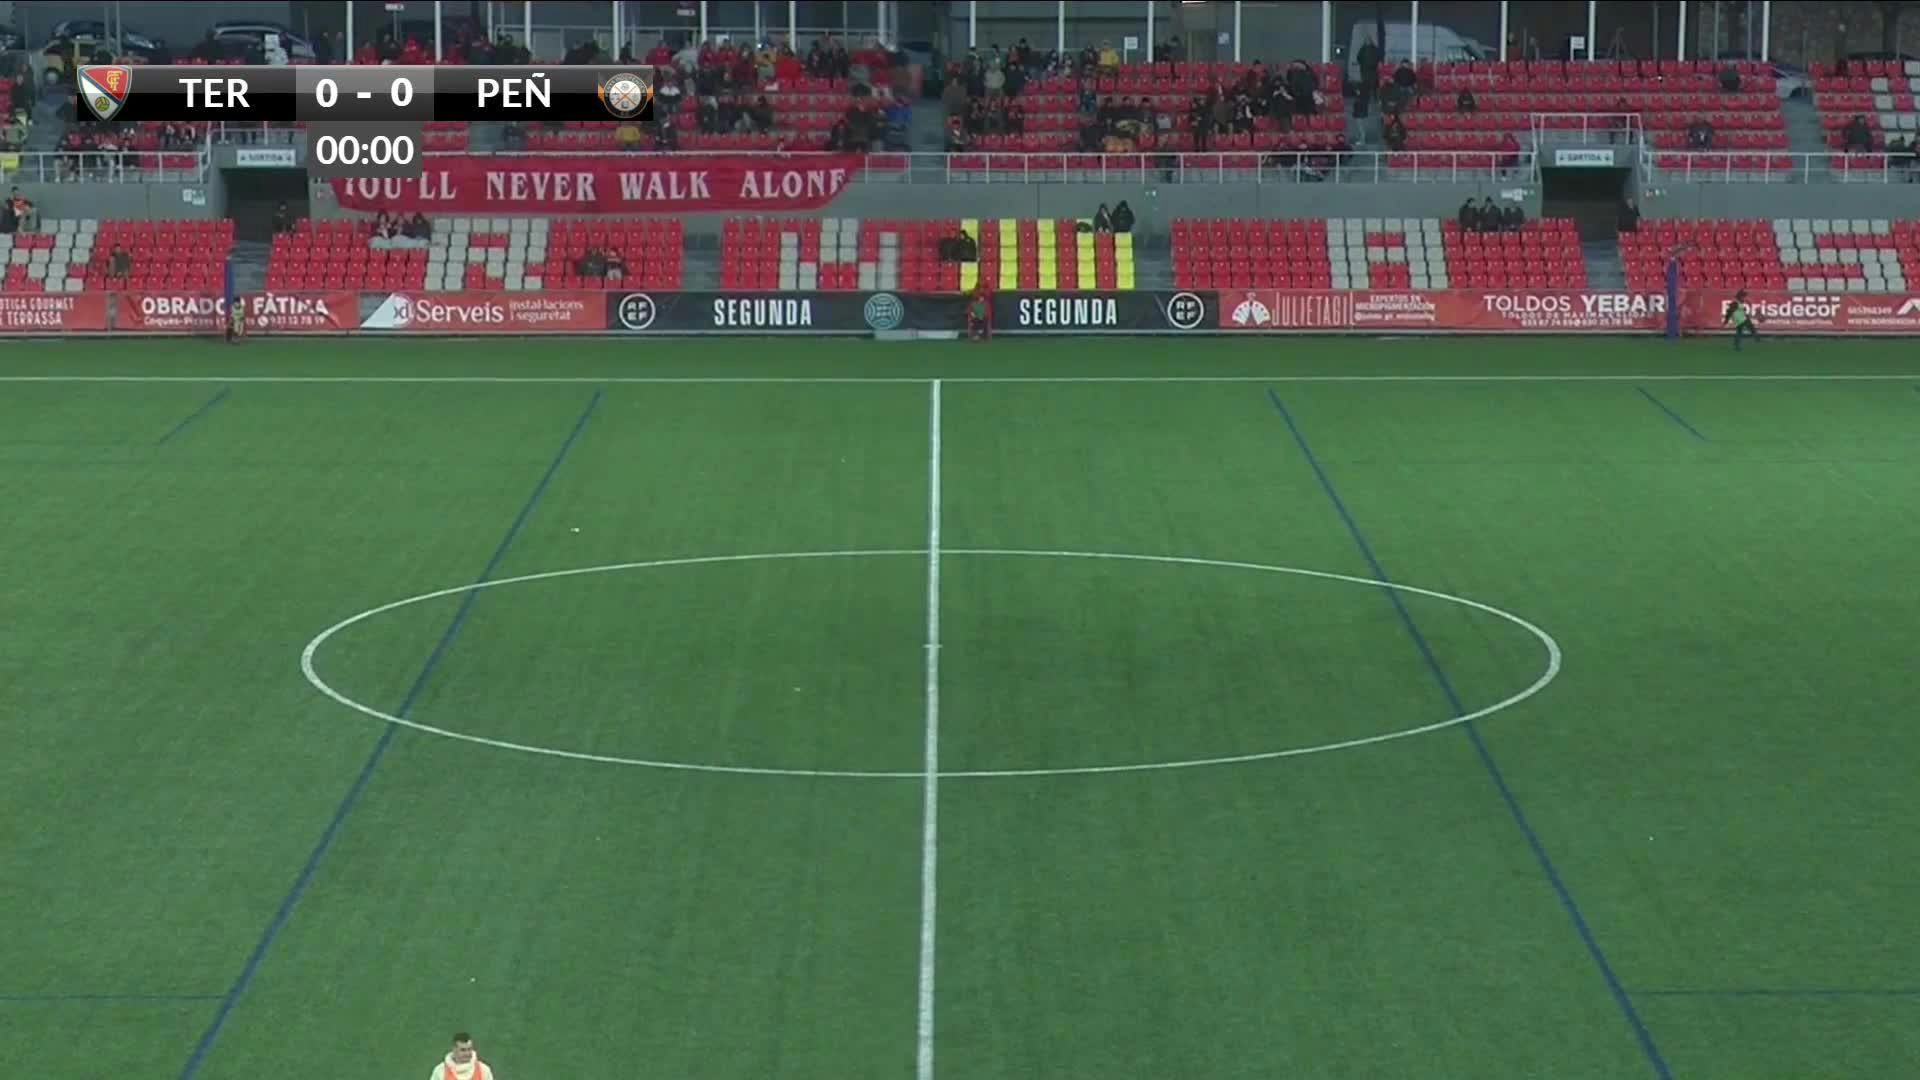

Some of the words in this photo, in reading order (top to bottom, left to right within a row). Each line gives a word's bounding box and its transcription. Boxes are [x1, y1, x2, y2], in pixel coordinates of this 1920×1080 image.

[486, 172, 596, 201] NEVER
[619, 171, 710, 200] WALK
[142, 297, 245, 314] OBRADO
[416, 299, 505, 322] Serveis
[714, 299, 812, 326] SEGUNDA
[1019, 298, 1117, 326] SEGUNDA
[1482, 295, 1571, 313] TOLDOS
[7, 311, 62, 326] TERRASSA
